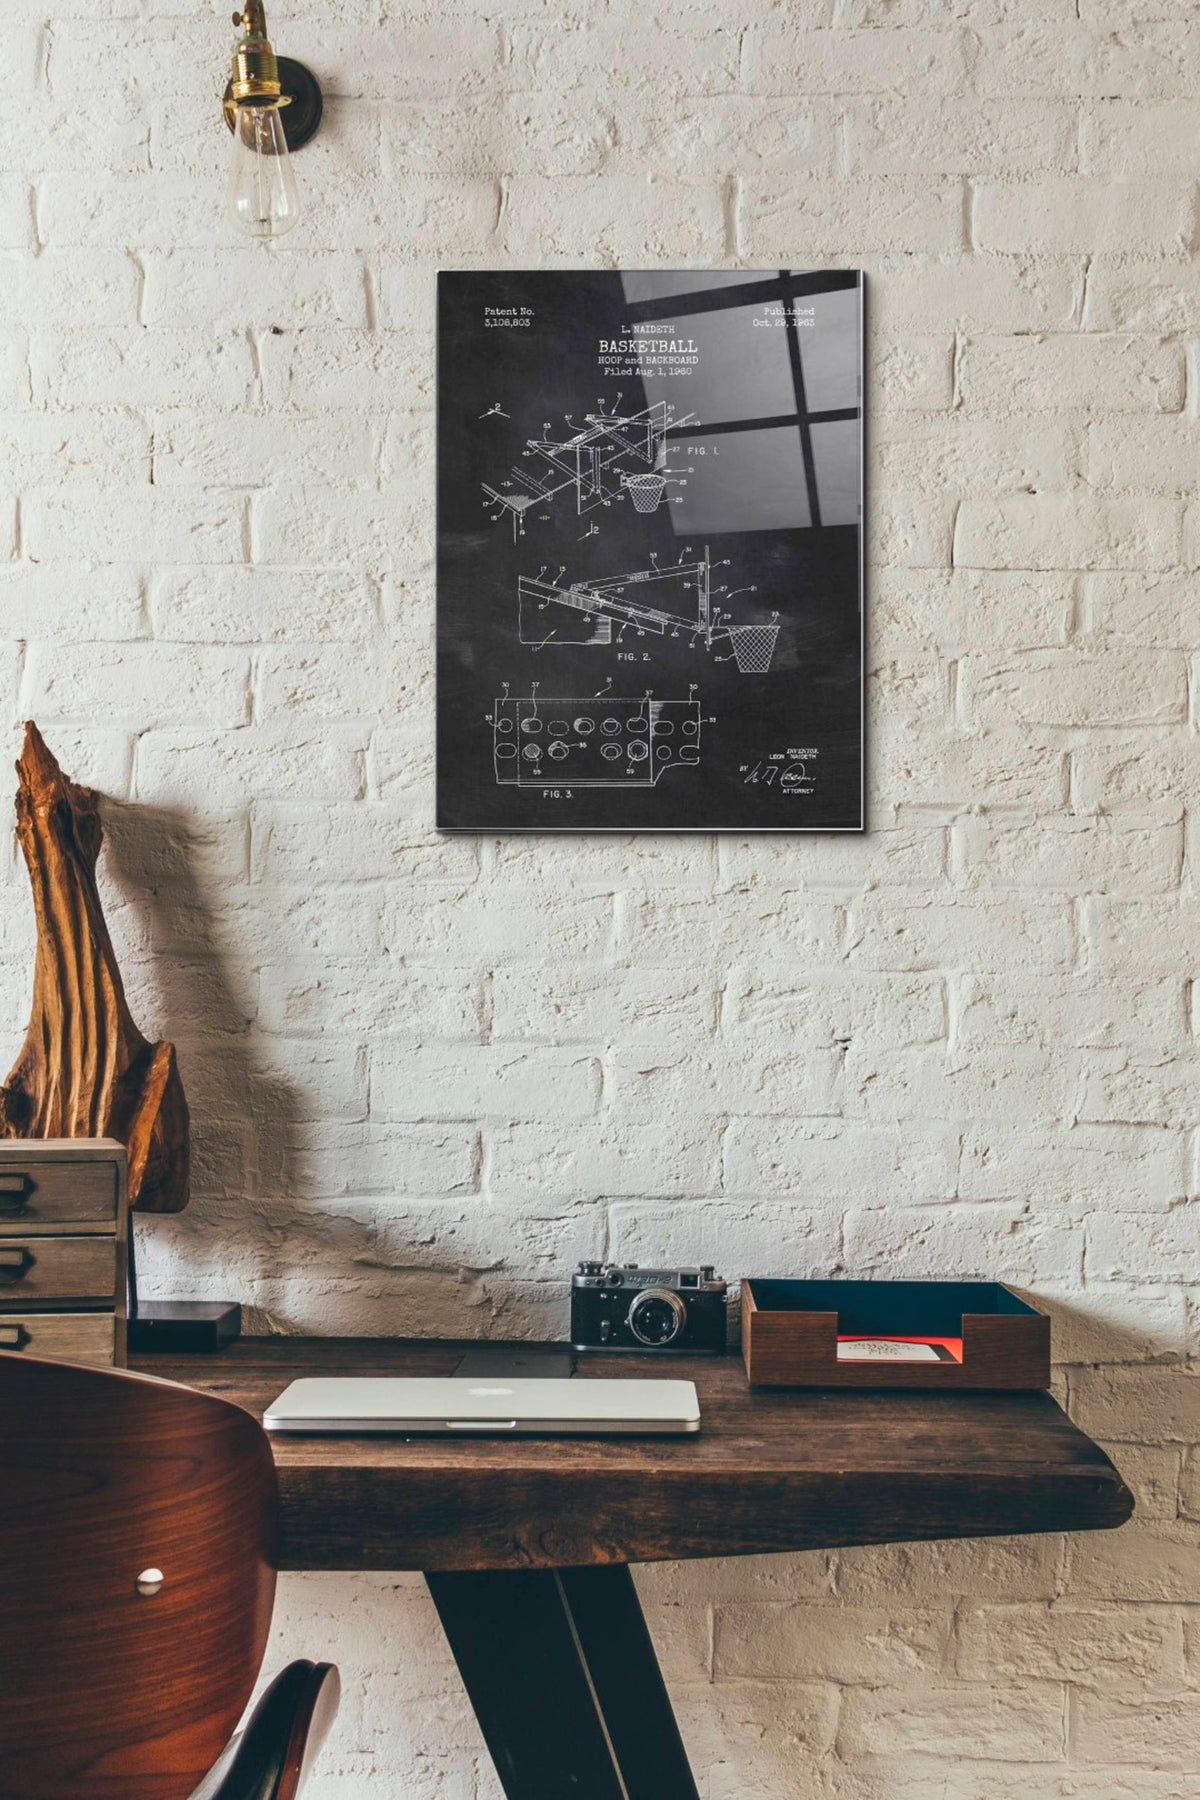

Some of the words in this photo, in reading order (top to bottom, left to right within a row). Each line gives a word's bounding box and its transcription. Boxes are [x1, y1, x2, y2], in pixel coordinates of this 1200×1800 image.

[484, 307, 518, 316] Patent
[520, 307, 535, 316] No.
[763, 307, 816, 316] Published
[484, 318, 531, 328] 3,106,803
[752, 318, 773, 327] Oct.
[621, 325, 631, 334] L.
[633, 325, 676, 334] NAIDETH
[599, 340, 699, 353] BASKETBALL
[598, 356, 623, 364] HOOP
[624, 356, 643, 364] and
[645, 356, 699, 364] BACKBOARD
[604, 367, 632, 376] Filed
[635, 367, 656, 378] Aug.
[669, 367, 693, 376] 1960
[688, 447, 708, 456] FIG.
[617, 652, 637, 661] FIG.
[642, 652, 651, 661] 2.
[543, 790, 563, 799] FIG.
[566, 790, 574, 799] 3.
